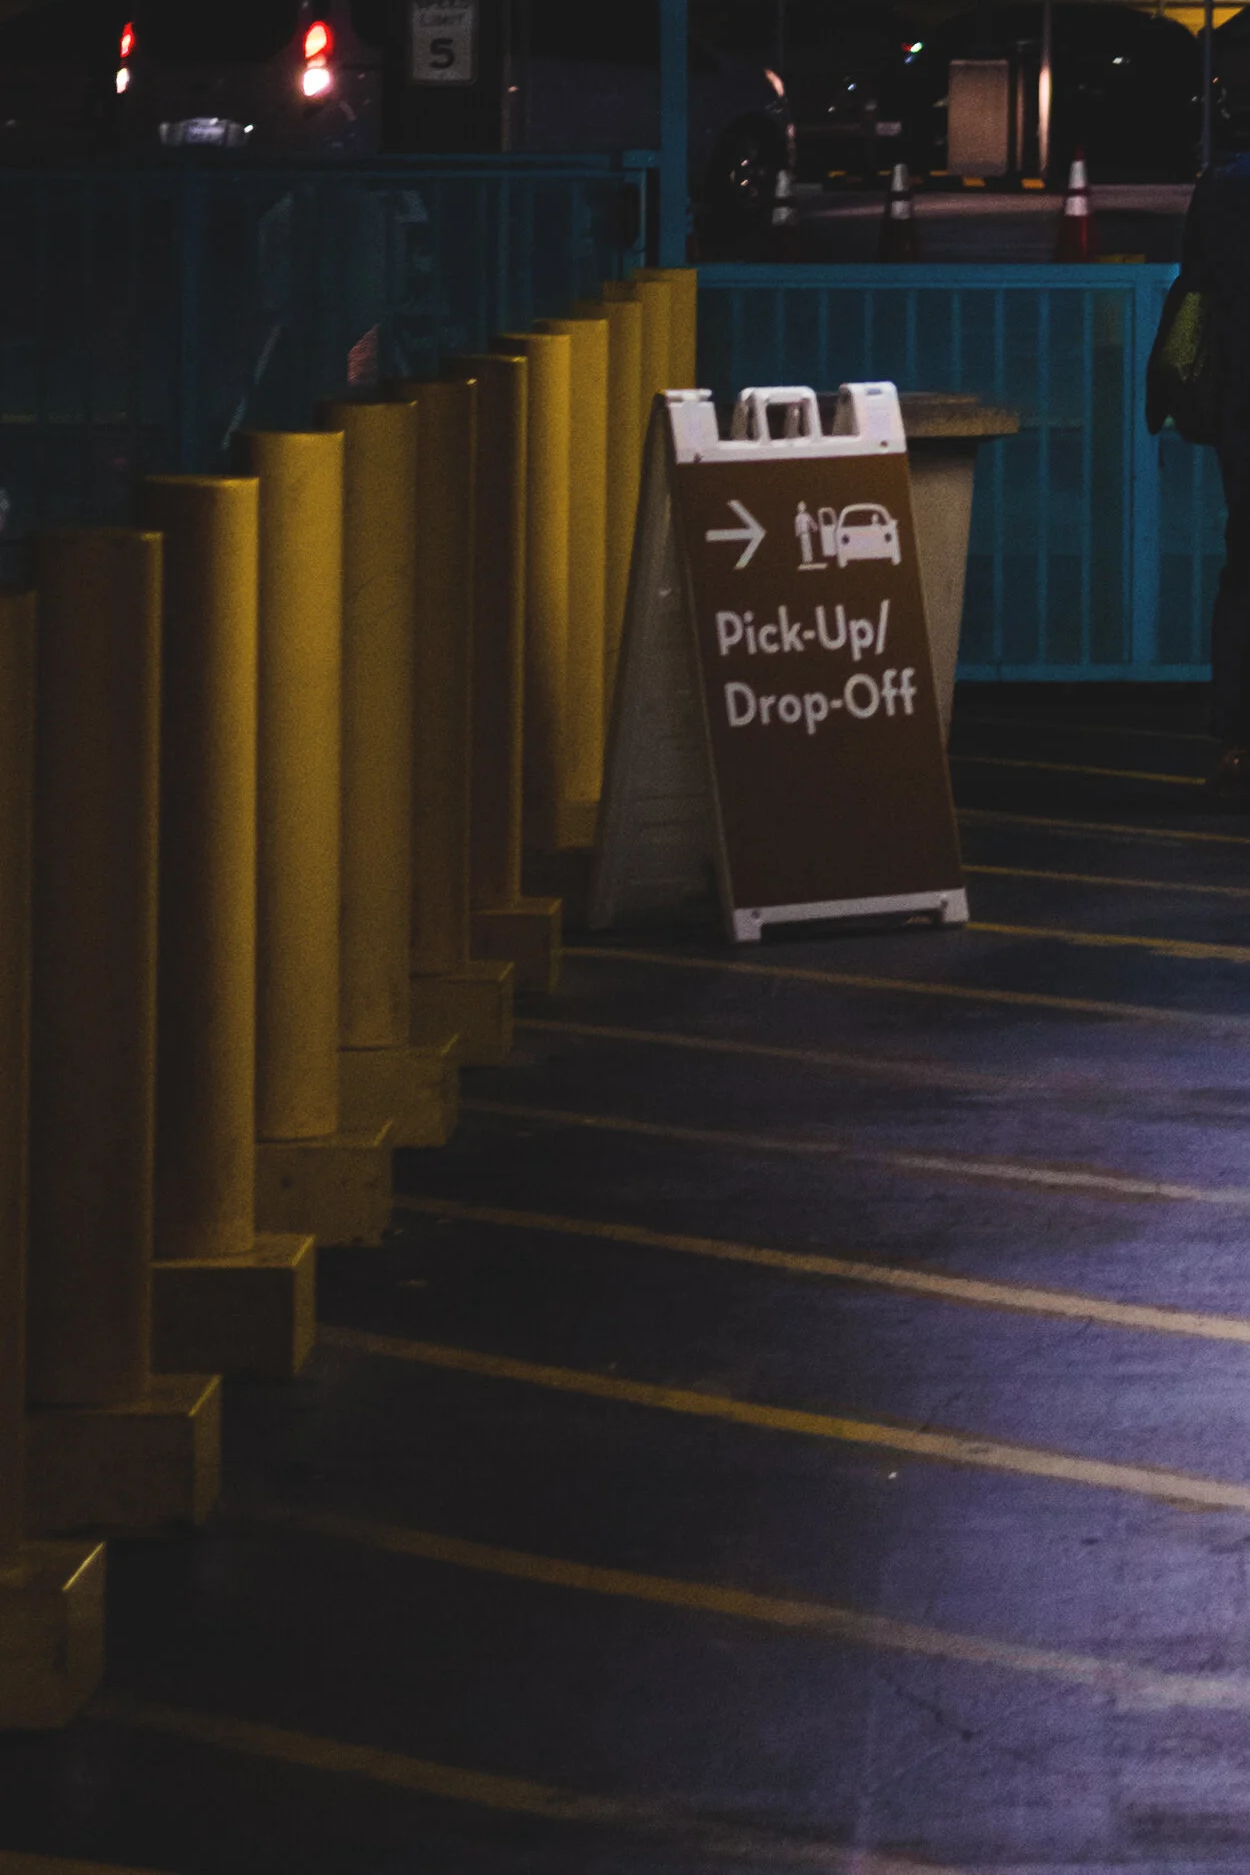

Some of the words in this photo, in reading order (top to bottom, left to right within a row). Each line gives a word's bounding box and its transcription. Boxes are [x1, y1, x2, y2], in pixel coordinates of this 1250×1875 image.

[429, 37, 456, 70] 5
[715, 598, 891, 663] Pick-Up/
[723, 666, 918, 736] Drop-Off
